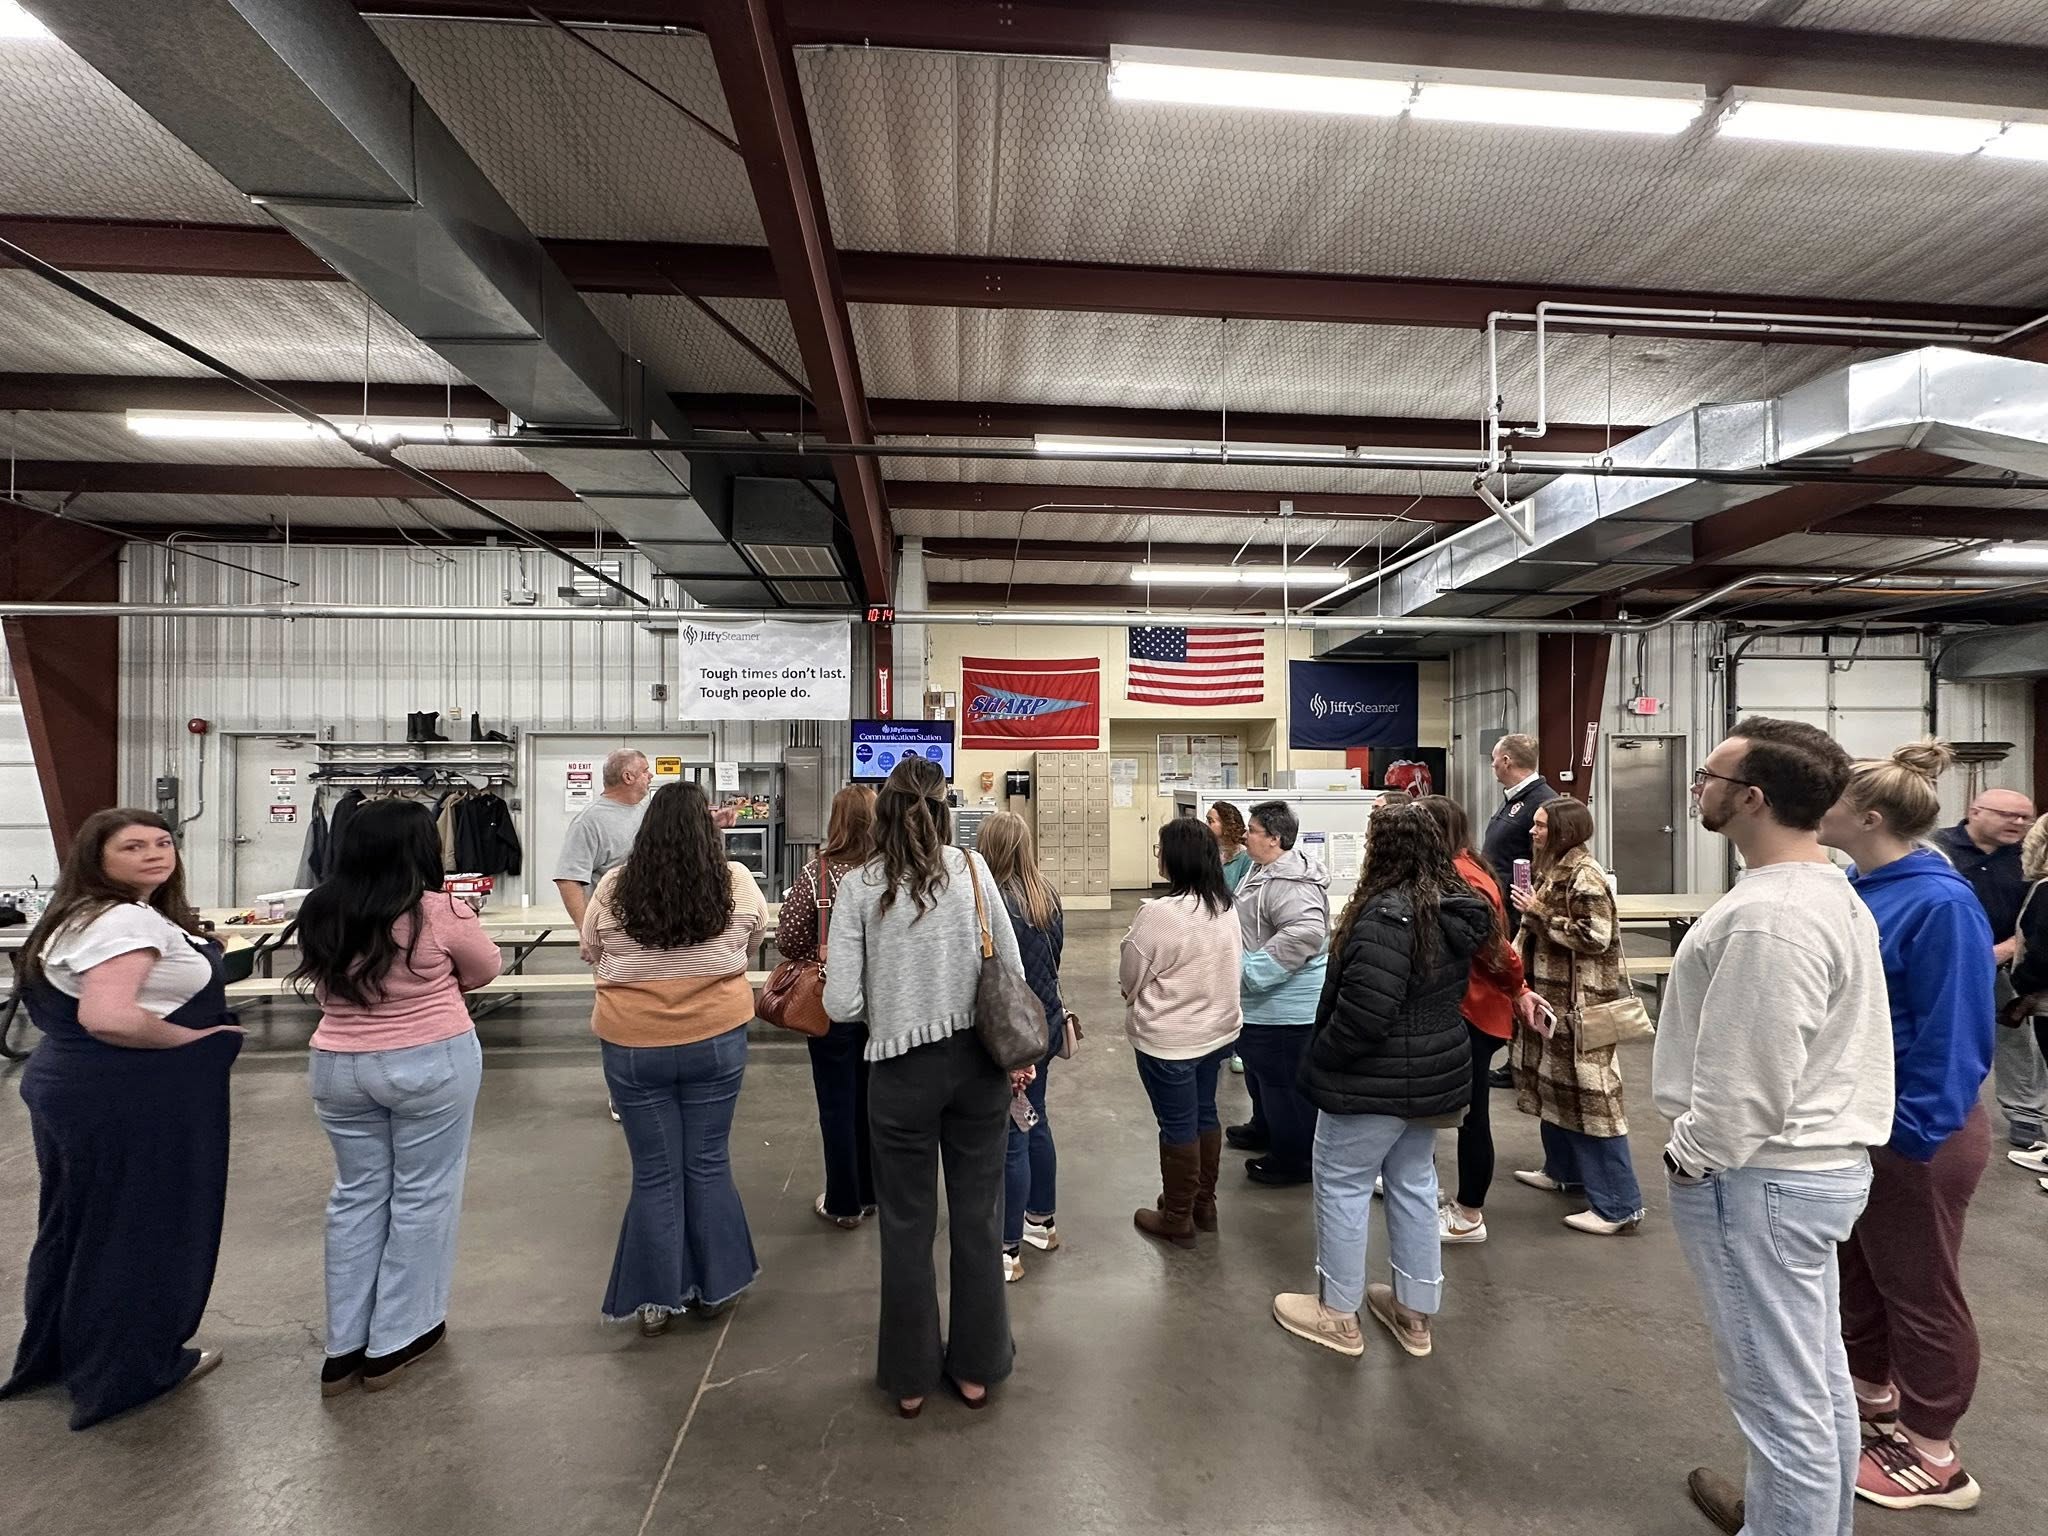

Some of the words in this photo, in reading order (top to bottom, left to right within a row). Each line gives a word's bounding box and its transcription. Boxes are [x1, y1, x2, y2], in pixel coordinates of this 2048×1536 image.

[868, 609, 893, 621] 10:14
[700, 631, 760, 643] JiffySteamer
[700, 668, 738, 681] Tough
[741, 668, 778, 679] times
[781, 667, 816, 679] don’t
[819, 667, 846, 679] last.
[700, 687, 738, 700] Tough
[742, 687, 786, 700] people
[790, 687, 811, 698] do.
[967, 695, 1049, 715] SHARP
[1330, 701, 1400, 716] JiffySteamer
[859, 733, 916, 741] Communication
[917, 733, 942, 741] Station
